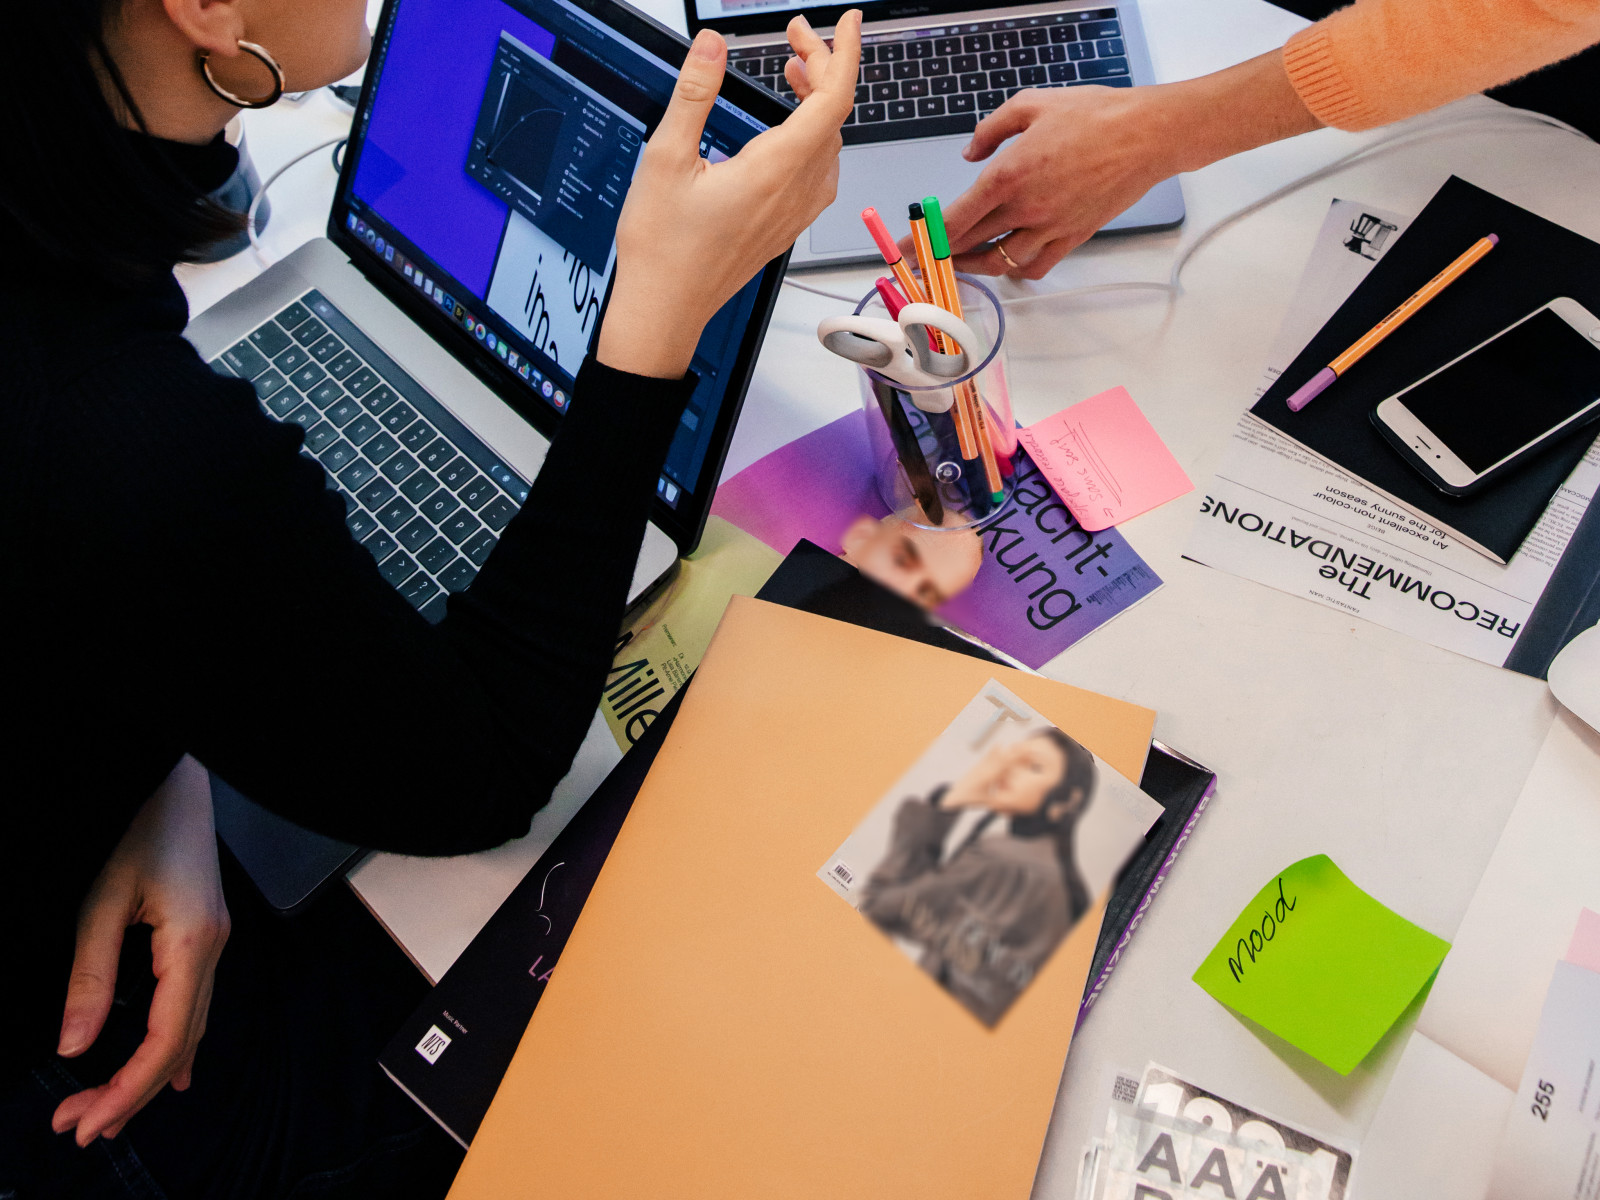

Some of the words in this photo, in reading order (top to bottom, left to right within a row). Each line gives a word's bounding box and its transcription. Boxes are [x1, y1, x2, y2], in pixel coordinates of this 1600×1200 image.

[1313, 491, 1376, 522] non-colour
[1326, 486, 1368, 506] season
[1370, 504, 1408, 523] sunny
[1408, 518, 1428, 530] the
[1378, 516, 1430, 542] excellent
[1429, 527, 1447, 540] for
[1433, 538, 1448, 550] An
[1200, 495, 1521, 638] RECOMMENDATIONS
[1308, 588, 1324, 599] MAN
[1318, 564, 1372, 600] The
[1324, 594, 1360, 614] FANTASTIC
[1164, 796, 1210, 868] BRICK
[1084, 875, 1165, 1008] MAGAZINE
[1228, 878, 1298, 984] mood
[421, 1032, 446, 1056] NTS
[1531, 1079, 1555, 1122] 255
